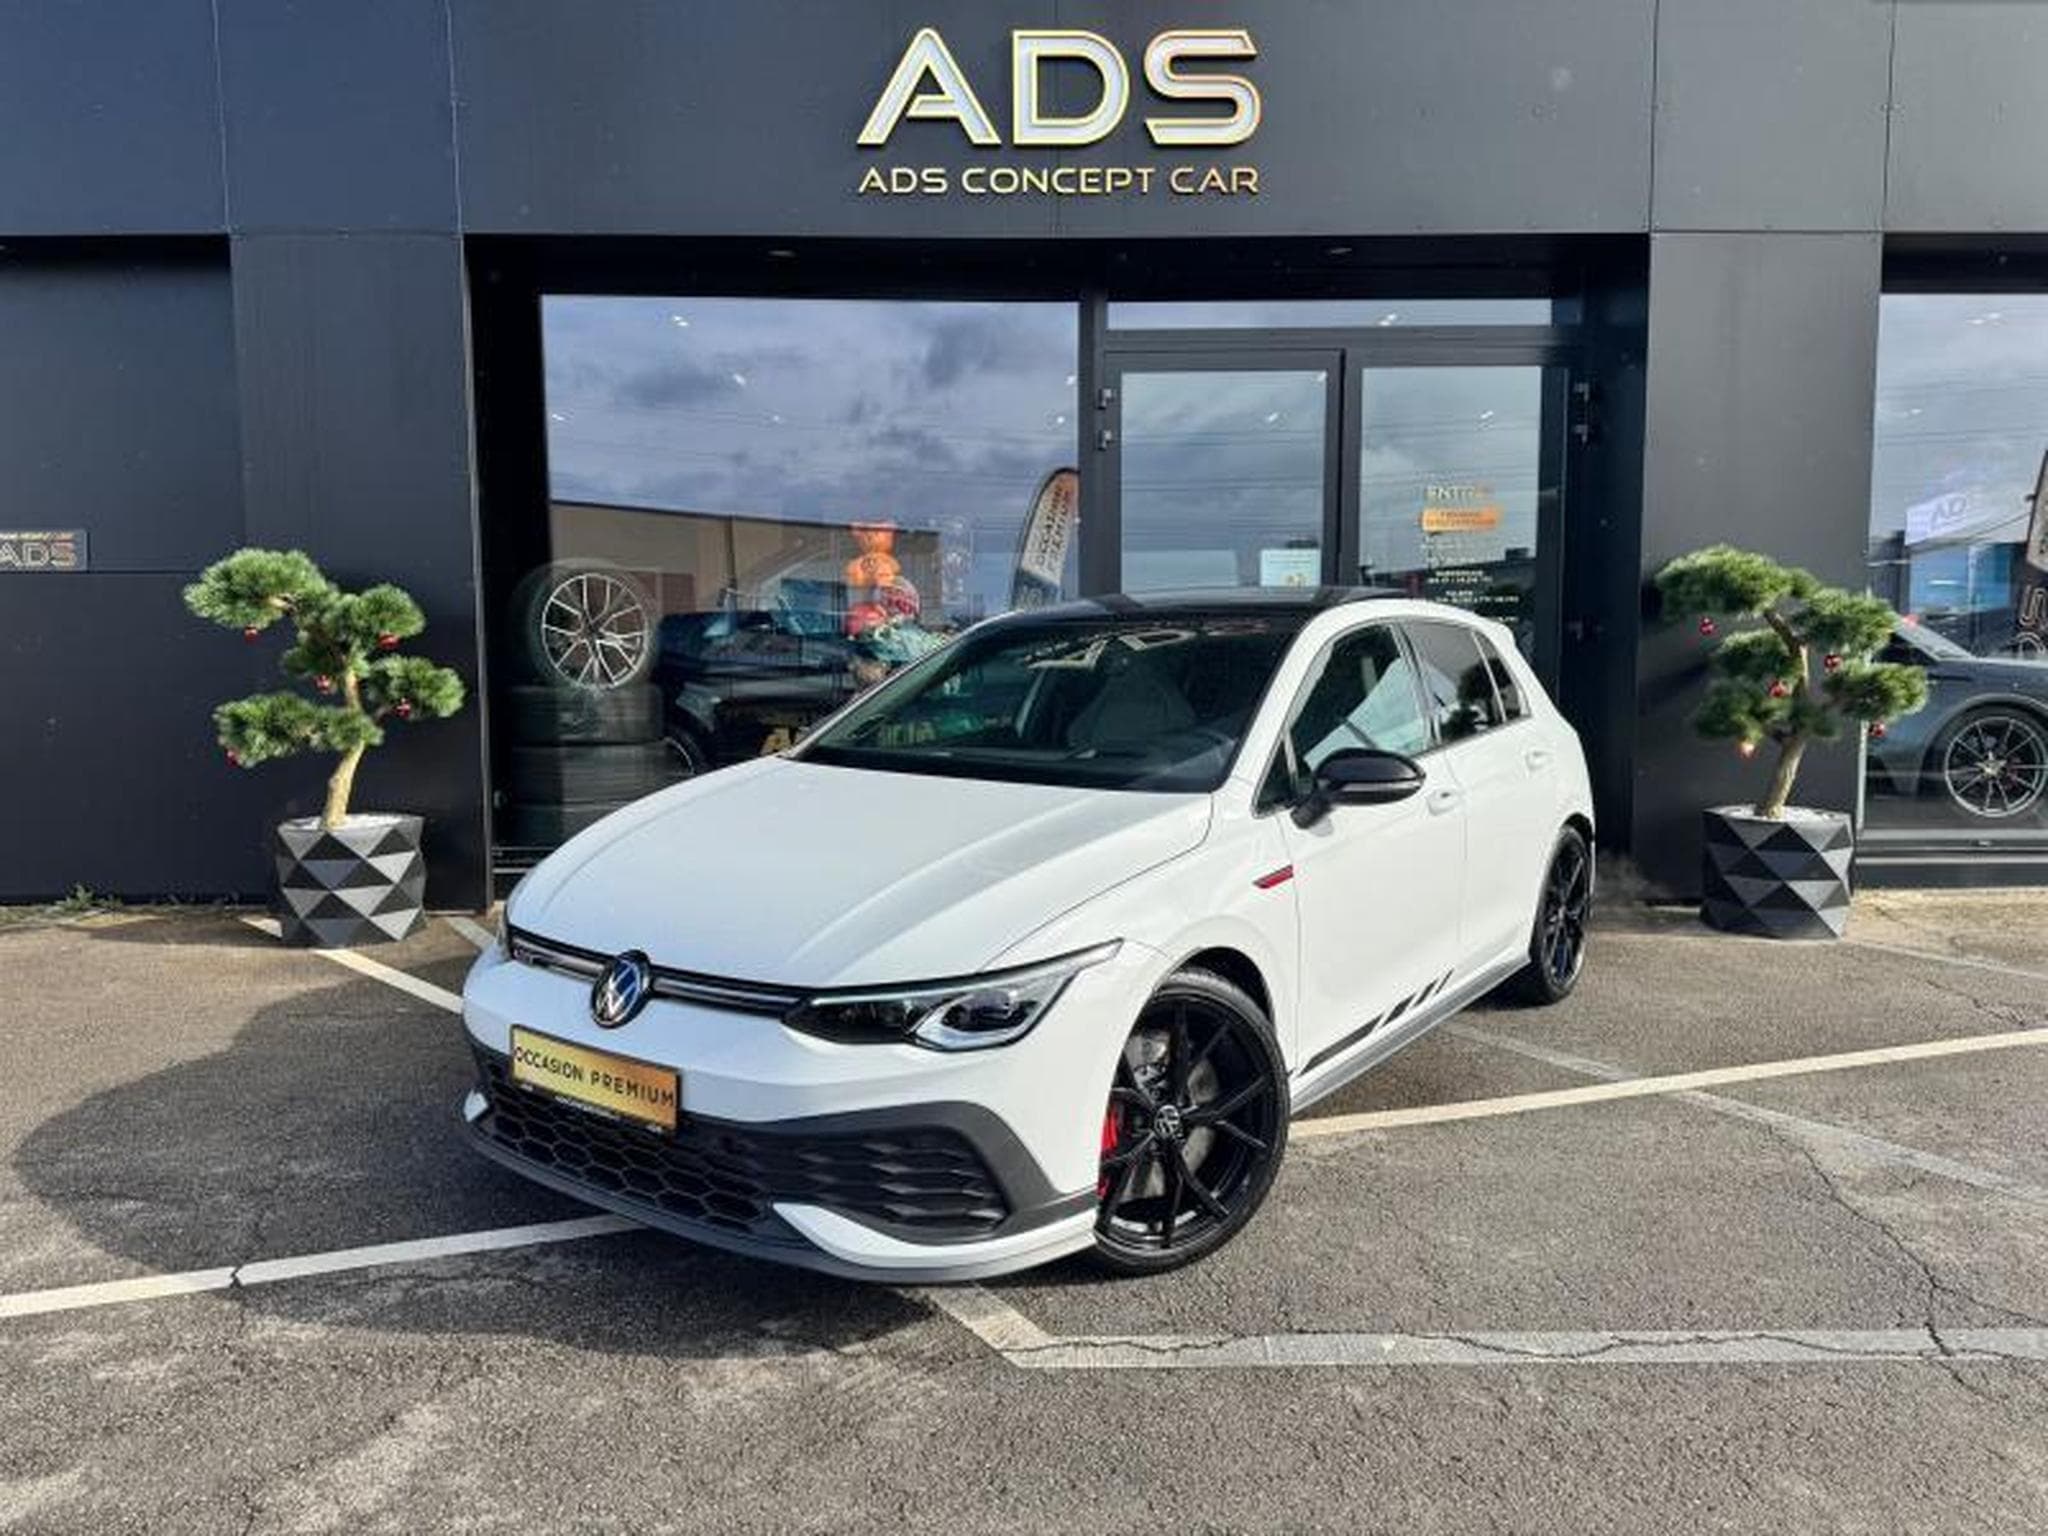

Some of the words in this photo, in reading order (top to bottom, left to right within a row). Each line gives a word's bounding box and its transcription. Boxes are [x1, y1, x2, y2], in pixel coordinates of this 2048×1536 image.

[857, 27, 1261, 145] ADS
[858, 167, 948, 194] ADS
[961, 168, 1155, 194] CONCEPT
[1170, 168, 1259, 194] CAR
[515, 1046, 584, 1082] OCCASION
[590, 1071, 674, 1107] PREMIUM
